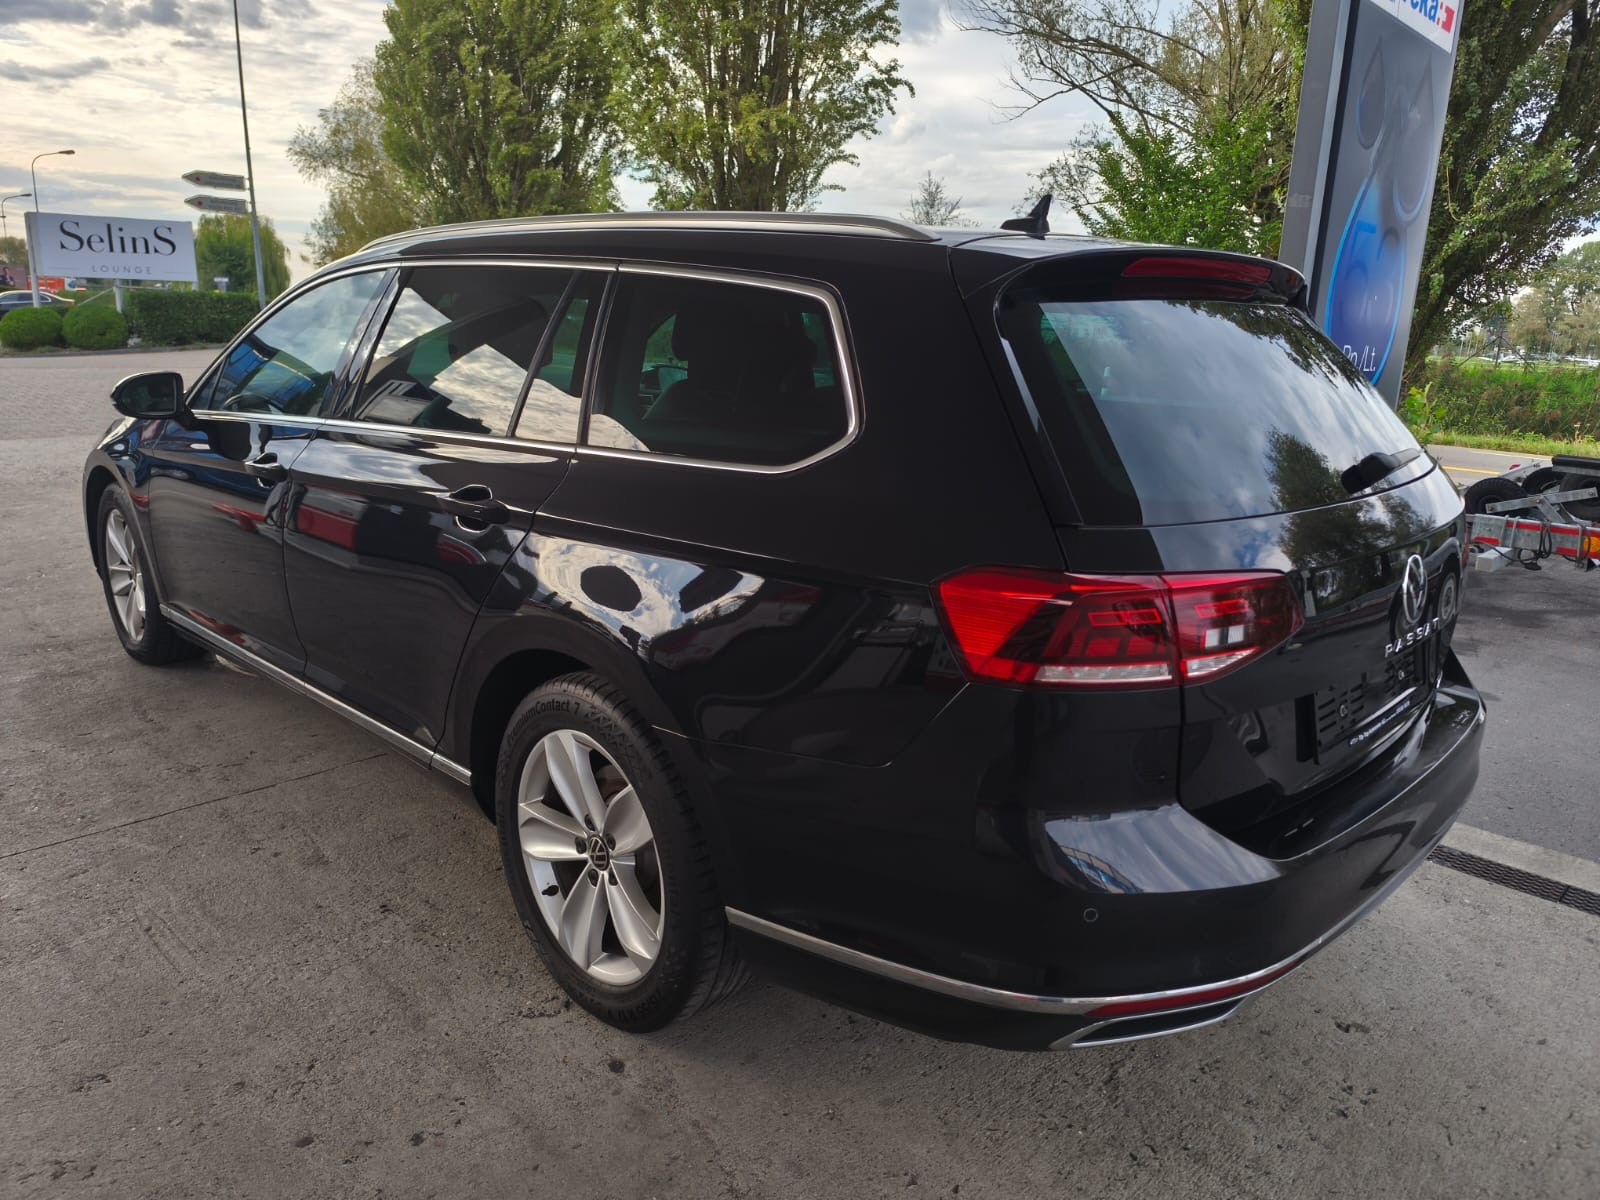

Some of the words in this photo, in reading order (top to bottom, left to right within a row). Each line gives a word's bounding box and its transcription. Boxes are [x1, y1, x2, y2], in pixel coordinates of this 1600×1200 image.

[59, 219, 177, 257] SelinS
[91, 264, 153, 275] LOUNGE
[1384, 617, 1440, 658] PASSAT
[574, 701, 581, 716] 7
